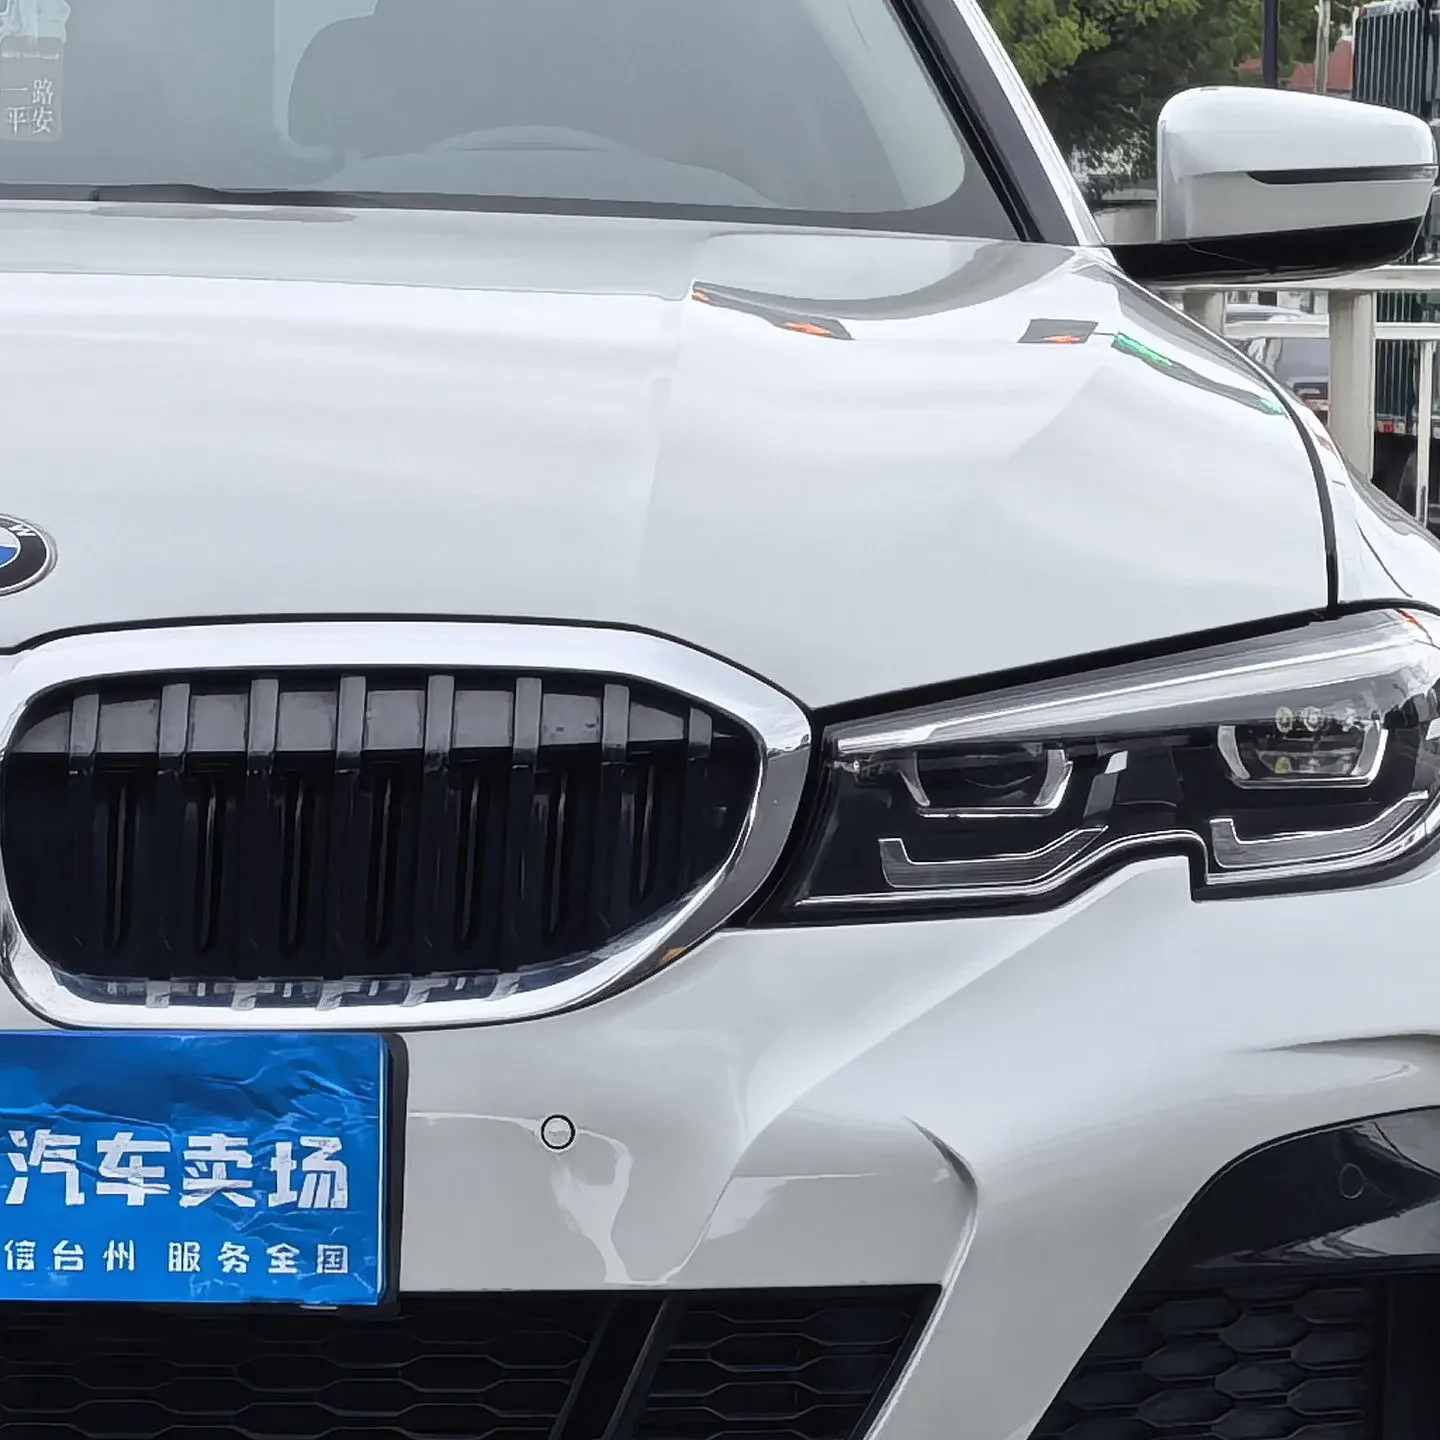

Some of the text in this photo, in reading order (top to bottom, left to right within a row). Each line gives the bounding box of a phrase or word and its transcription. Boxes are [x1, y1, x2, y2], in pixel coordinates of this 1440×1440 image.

[3, 77, 55, 107] 一路
[5, 106, 54, 137] 平安
[167, 1241, 351, 1275] 服务全国
